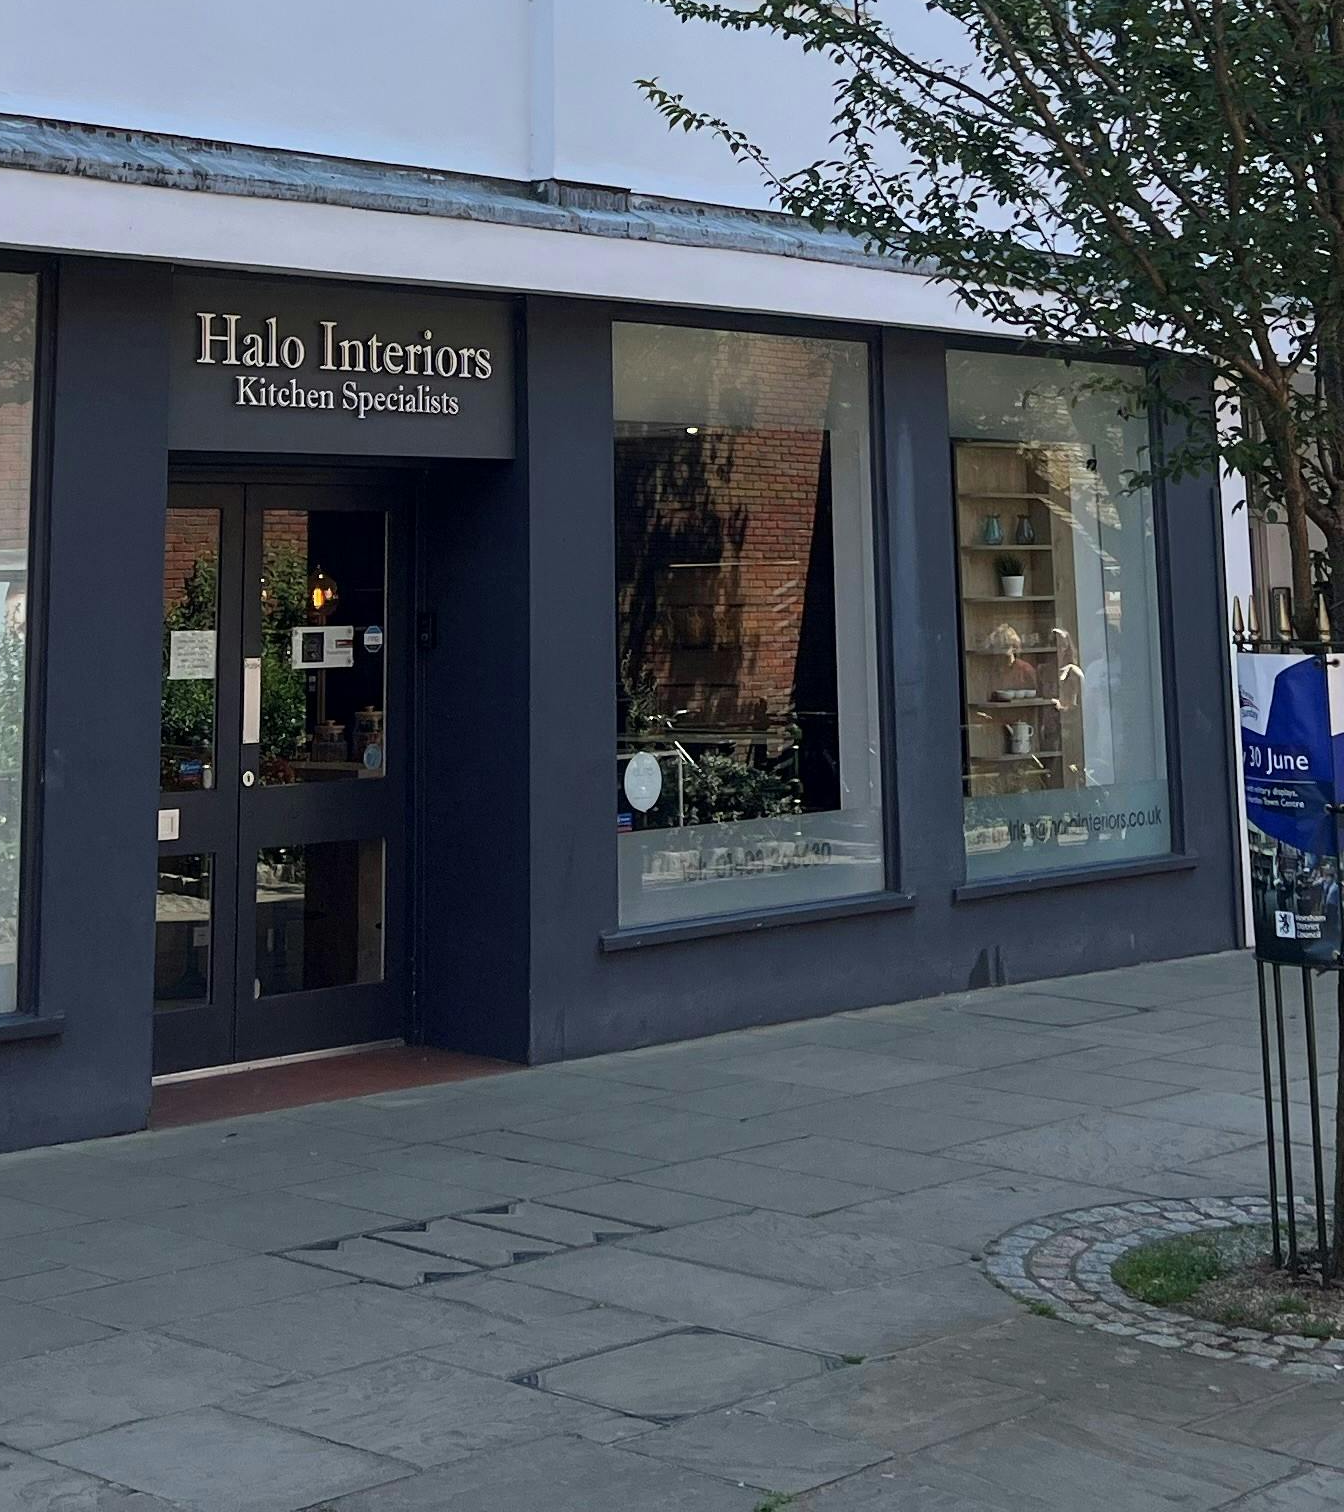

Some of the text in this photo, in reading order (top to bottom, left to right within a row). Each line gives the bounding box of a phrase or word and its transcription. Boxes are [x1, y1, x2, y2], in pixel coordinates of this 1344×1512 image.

[196, 312, 493, 380] Halo Interiors
[235, 375, 460, 419] Kitchen Specialists
[1249, 745, 1262, 768] 30
[1266, 747, 1309, 775] June
